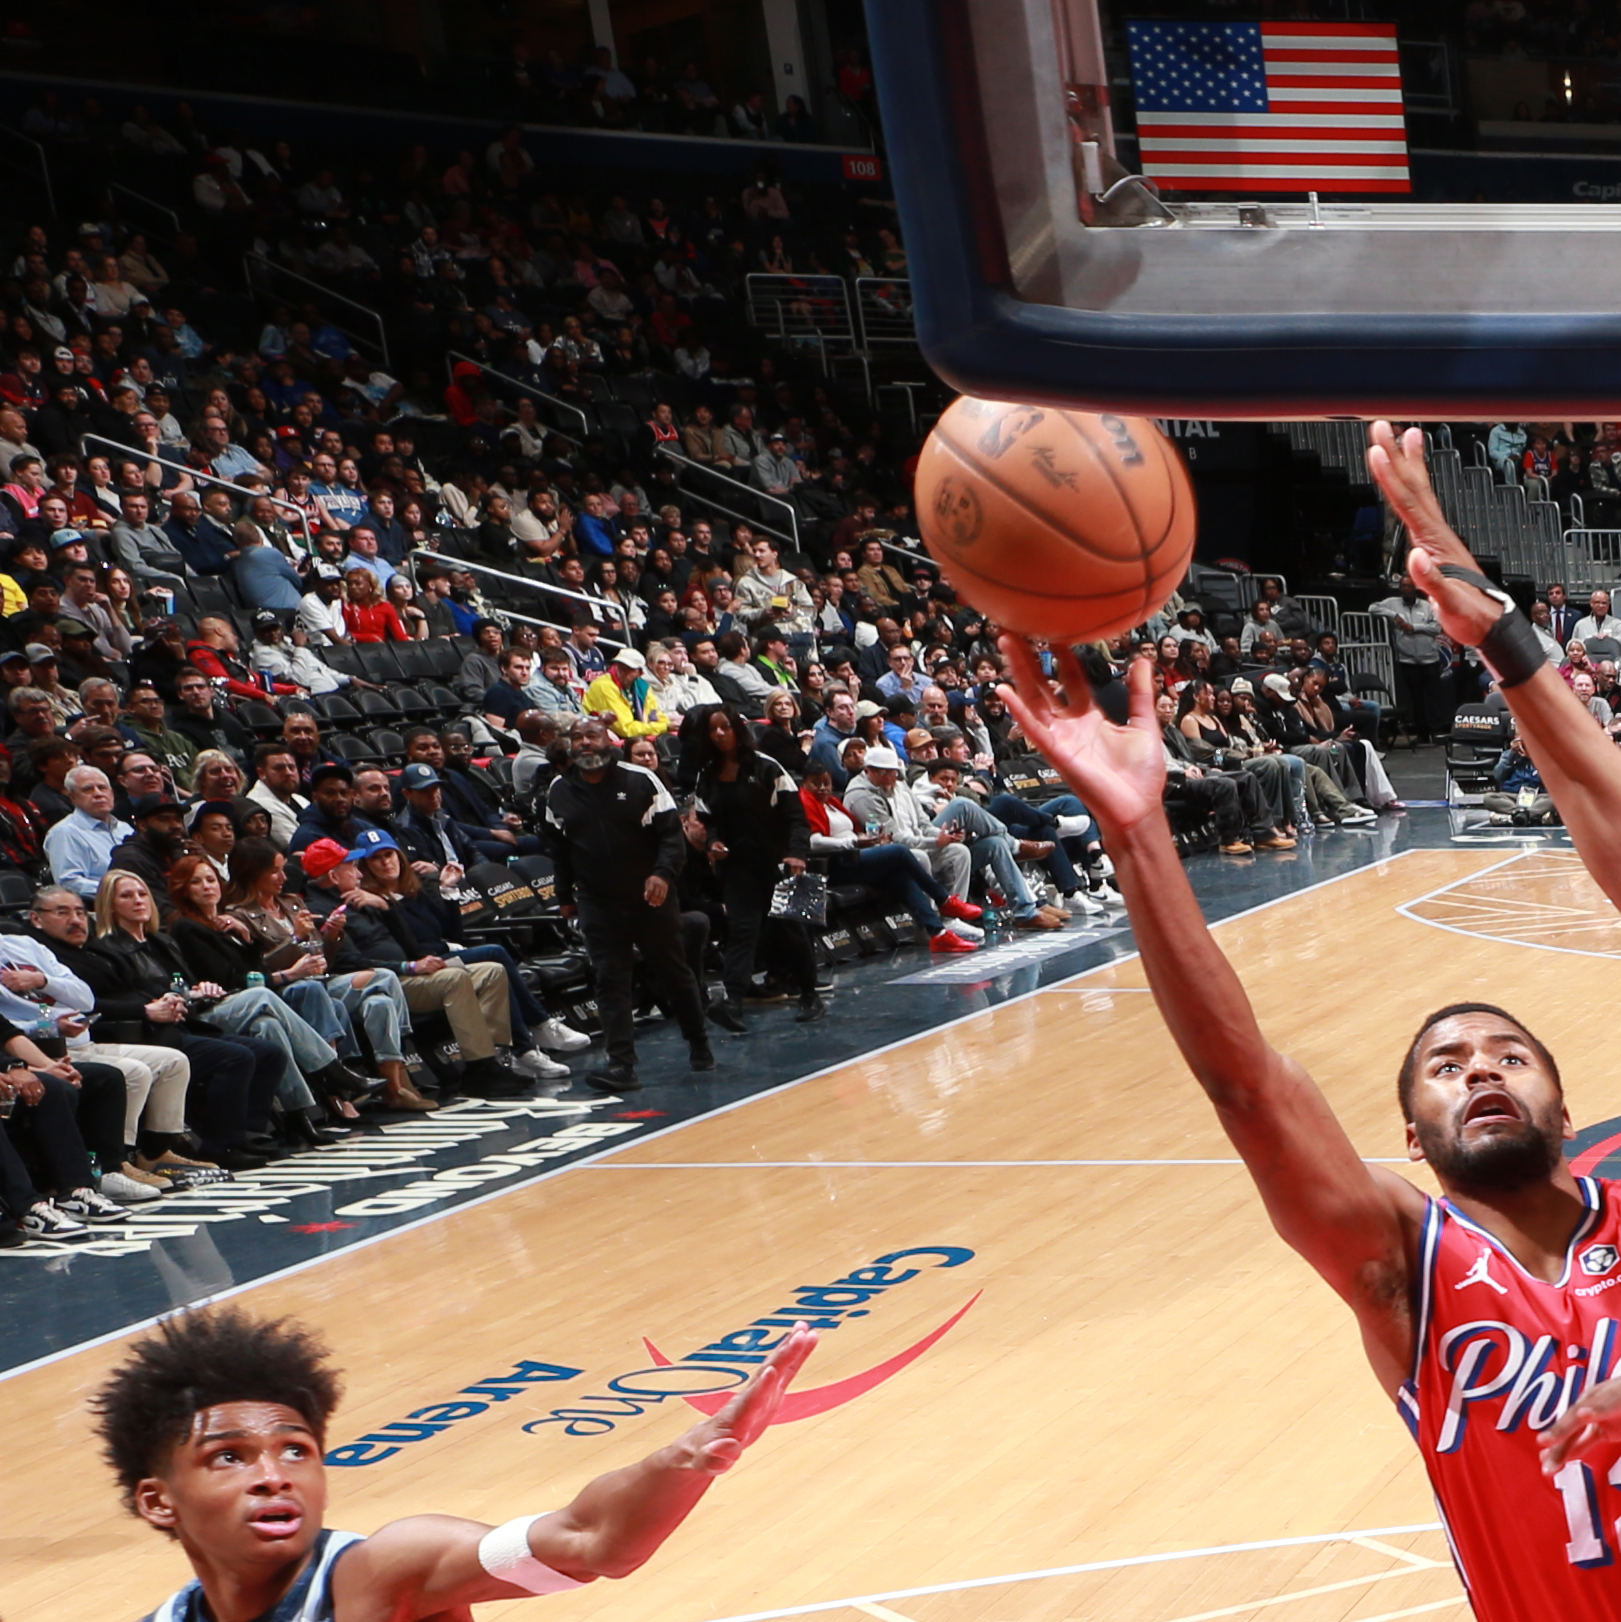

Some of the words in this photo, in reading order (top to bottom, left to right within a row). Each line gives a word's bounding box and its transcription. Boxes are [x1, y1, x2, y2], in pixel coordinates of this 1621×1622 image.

[849, 161, 876, 176] 108
[1454, 714, 1500, 726] CAESARS
[334, 1121, 643, 1217] BEYOND
[322, 1359, 588, 1468] Arena
